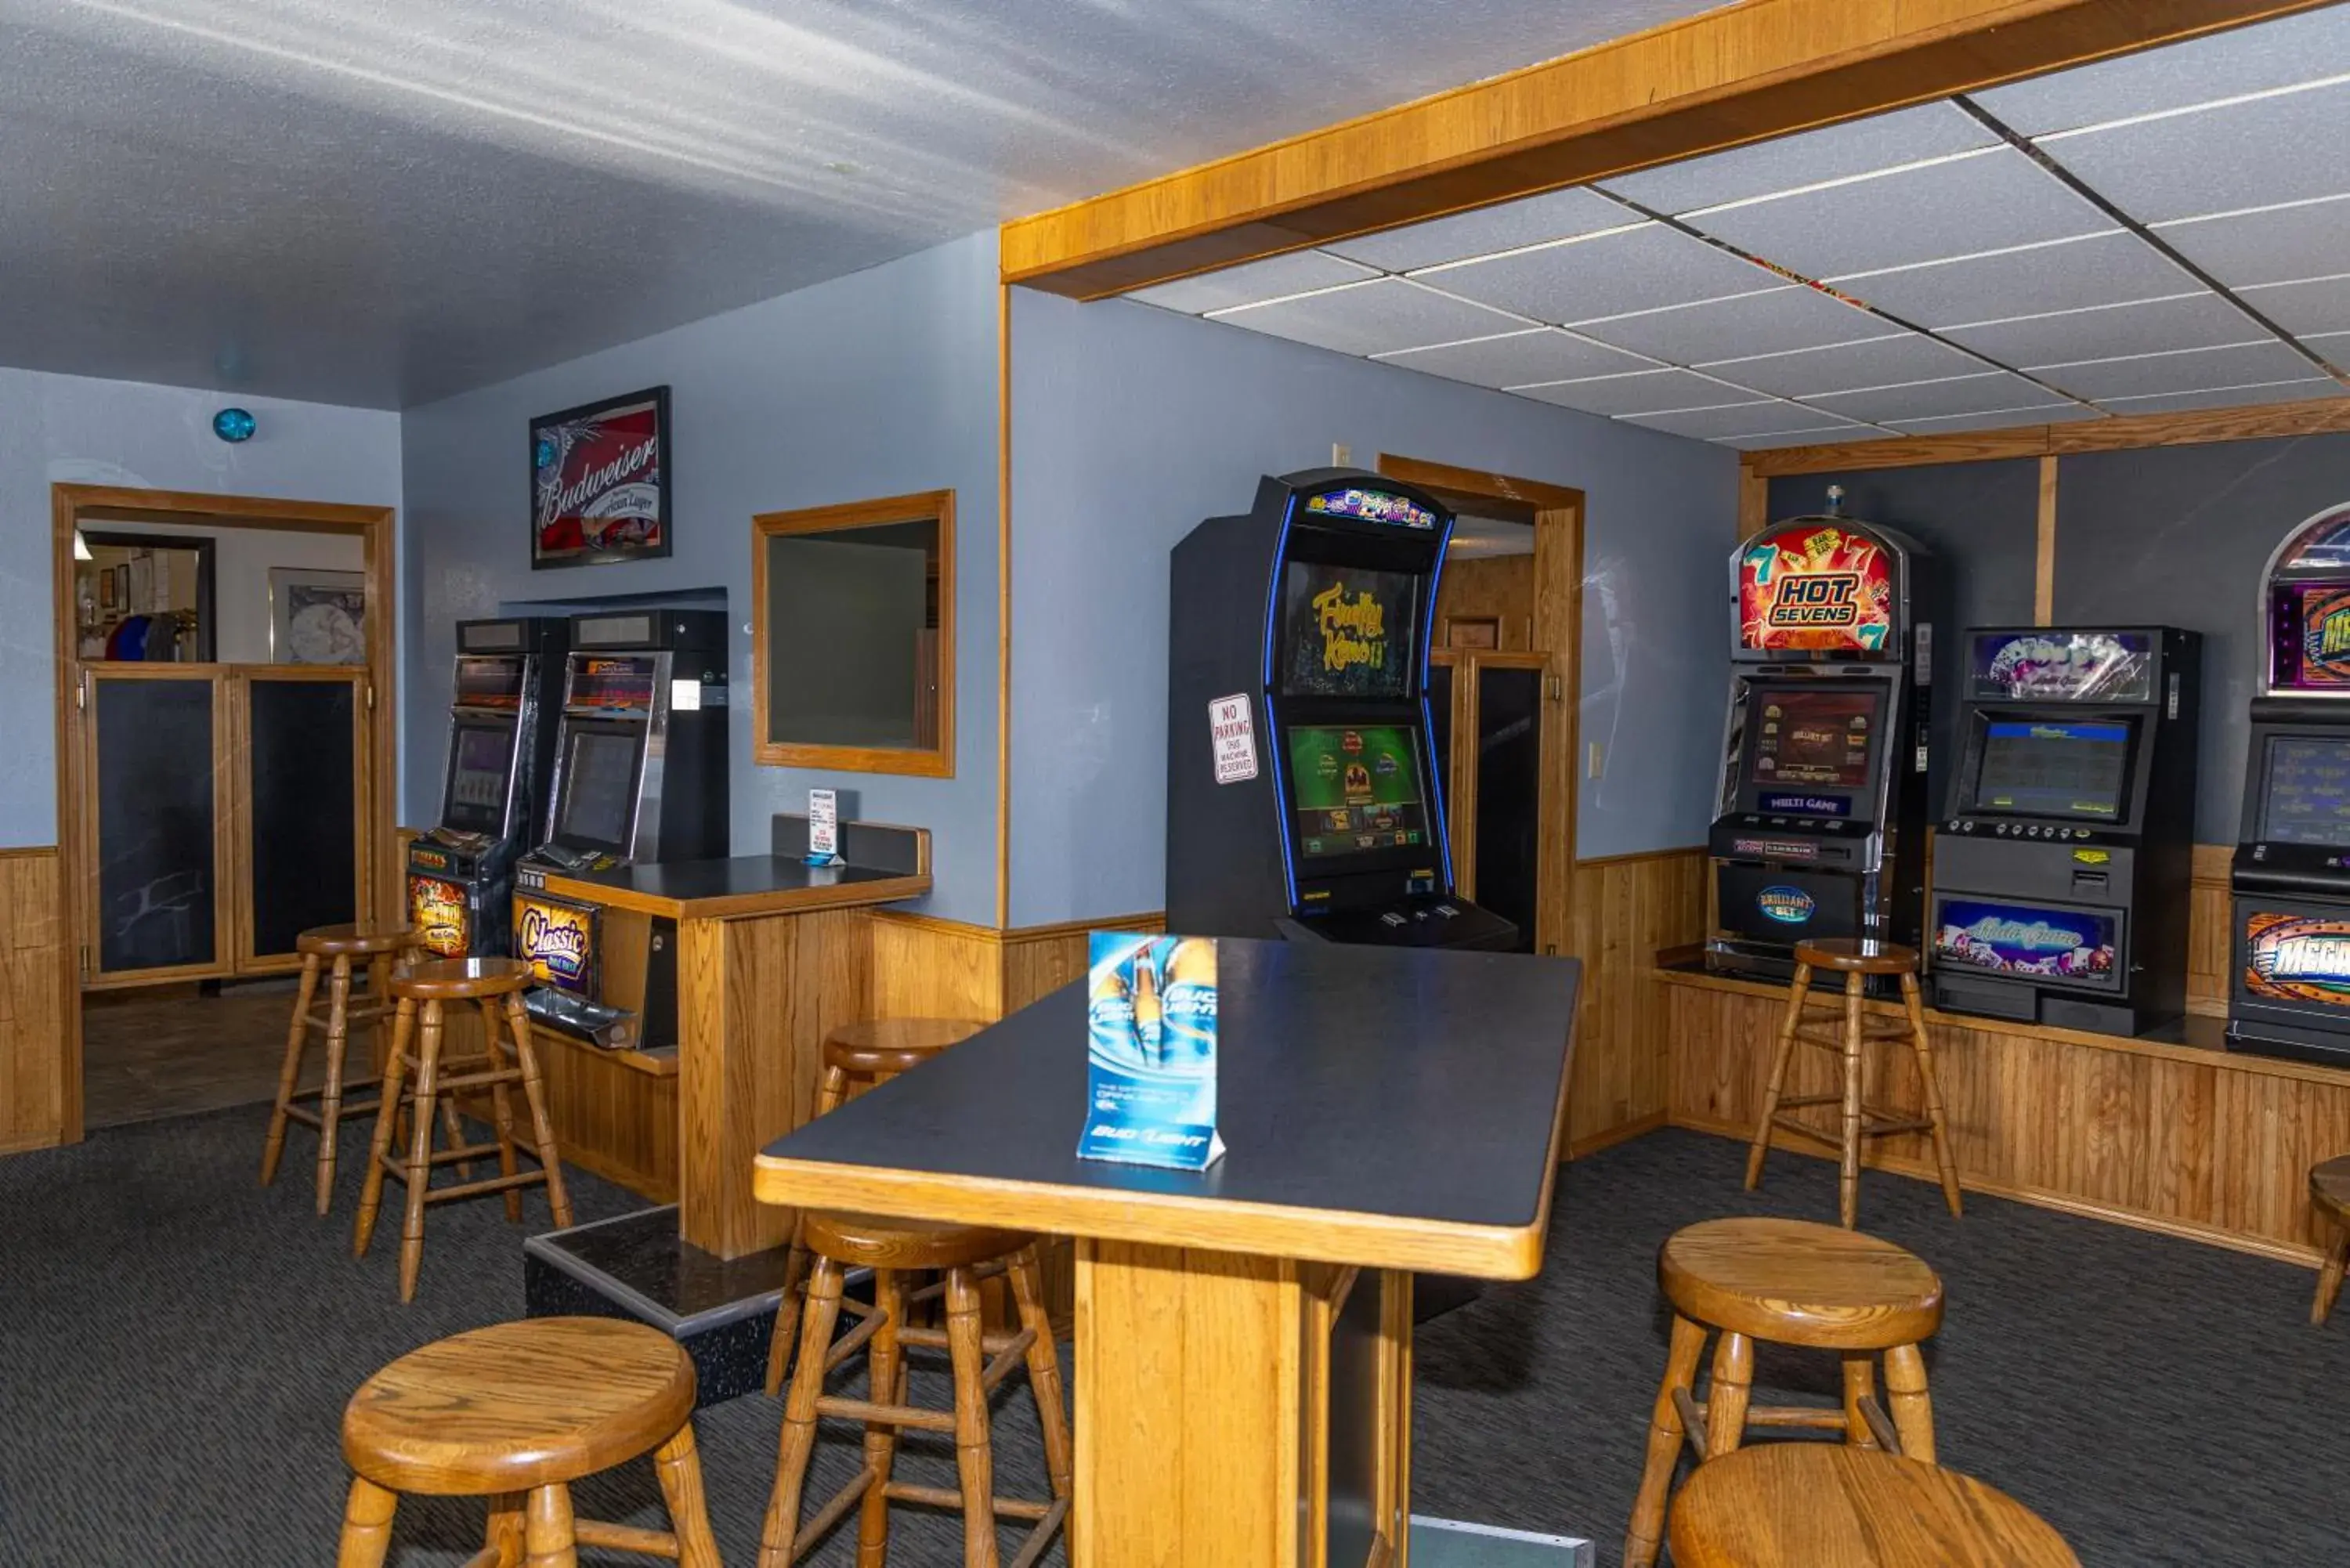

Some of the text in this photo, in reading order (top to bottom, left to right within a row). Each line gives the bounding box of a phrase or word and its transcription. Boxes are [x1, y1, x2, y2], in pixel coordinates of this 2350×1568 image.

[542, 437, 657, 530] Budweiser
[1781, 579, 1853, 604] HOT
[1773, 608, 1852, 622] SEVENS
[1223, 705, 1237, 721] NO
[1215, 720, 1250, 739] PARKING
[1220, 759, 1252, 773] RESERVED
[1771, 798, 1838, 811] MULTI GAME
[1760, 894, 1810, 909] BRILLIANT
[1776, 906, 1796, 916] BET
[520, 909, 584, 957] Classic
[1090, 1125, 1207, 1147] BUD LIGHT
